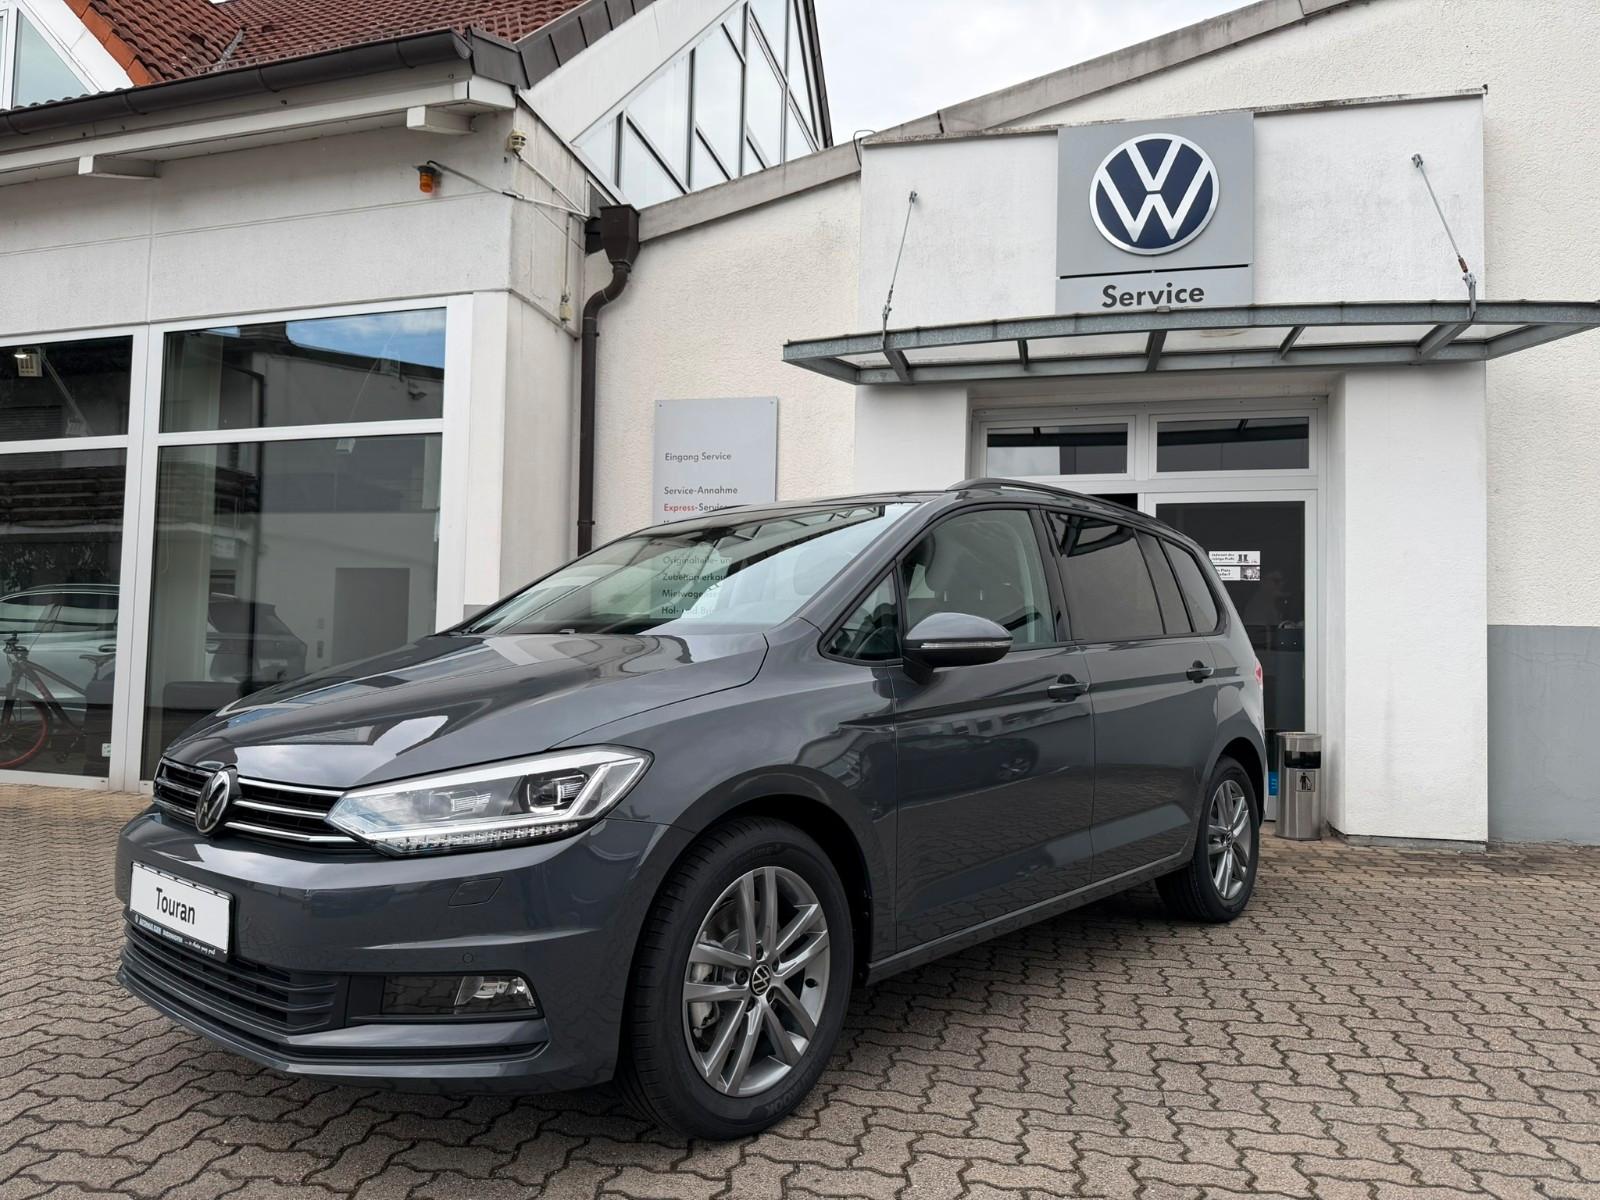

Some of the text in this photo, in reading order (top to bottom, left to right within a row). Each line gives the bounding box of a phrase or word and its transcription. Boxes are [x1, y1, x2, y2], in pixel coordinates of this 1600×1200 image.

[1102, 282, 1205, 308] Service
[664, 451, 732, 463] Eingang Service
[663, 485, 738, 495] Service-Annahme
[156, 886, 196, 925] Touran
